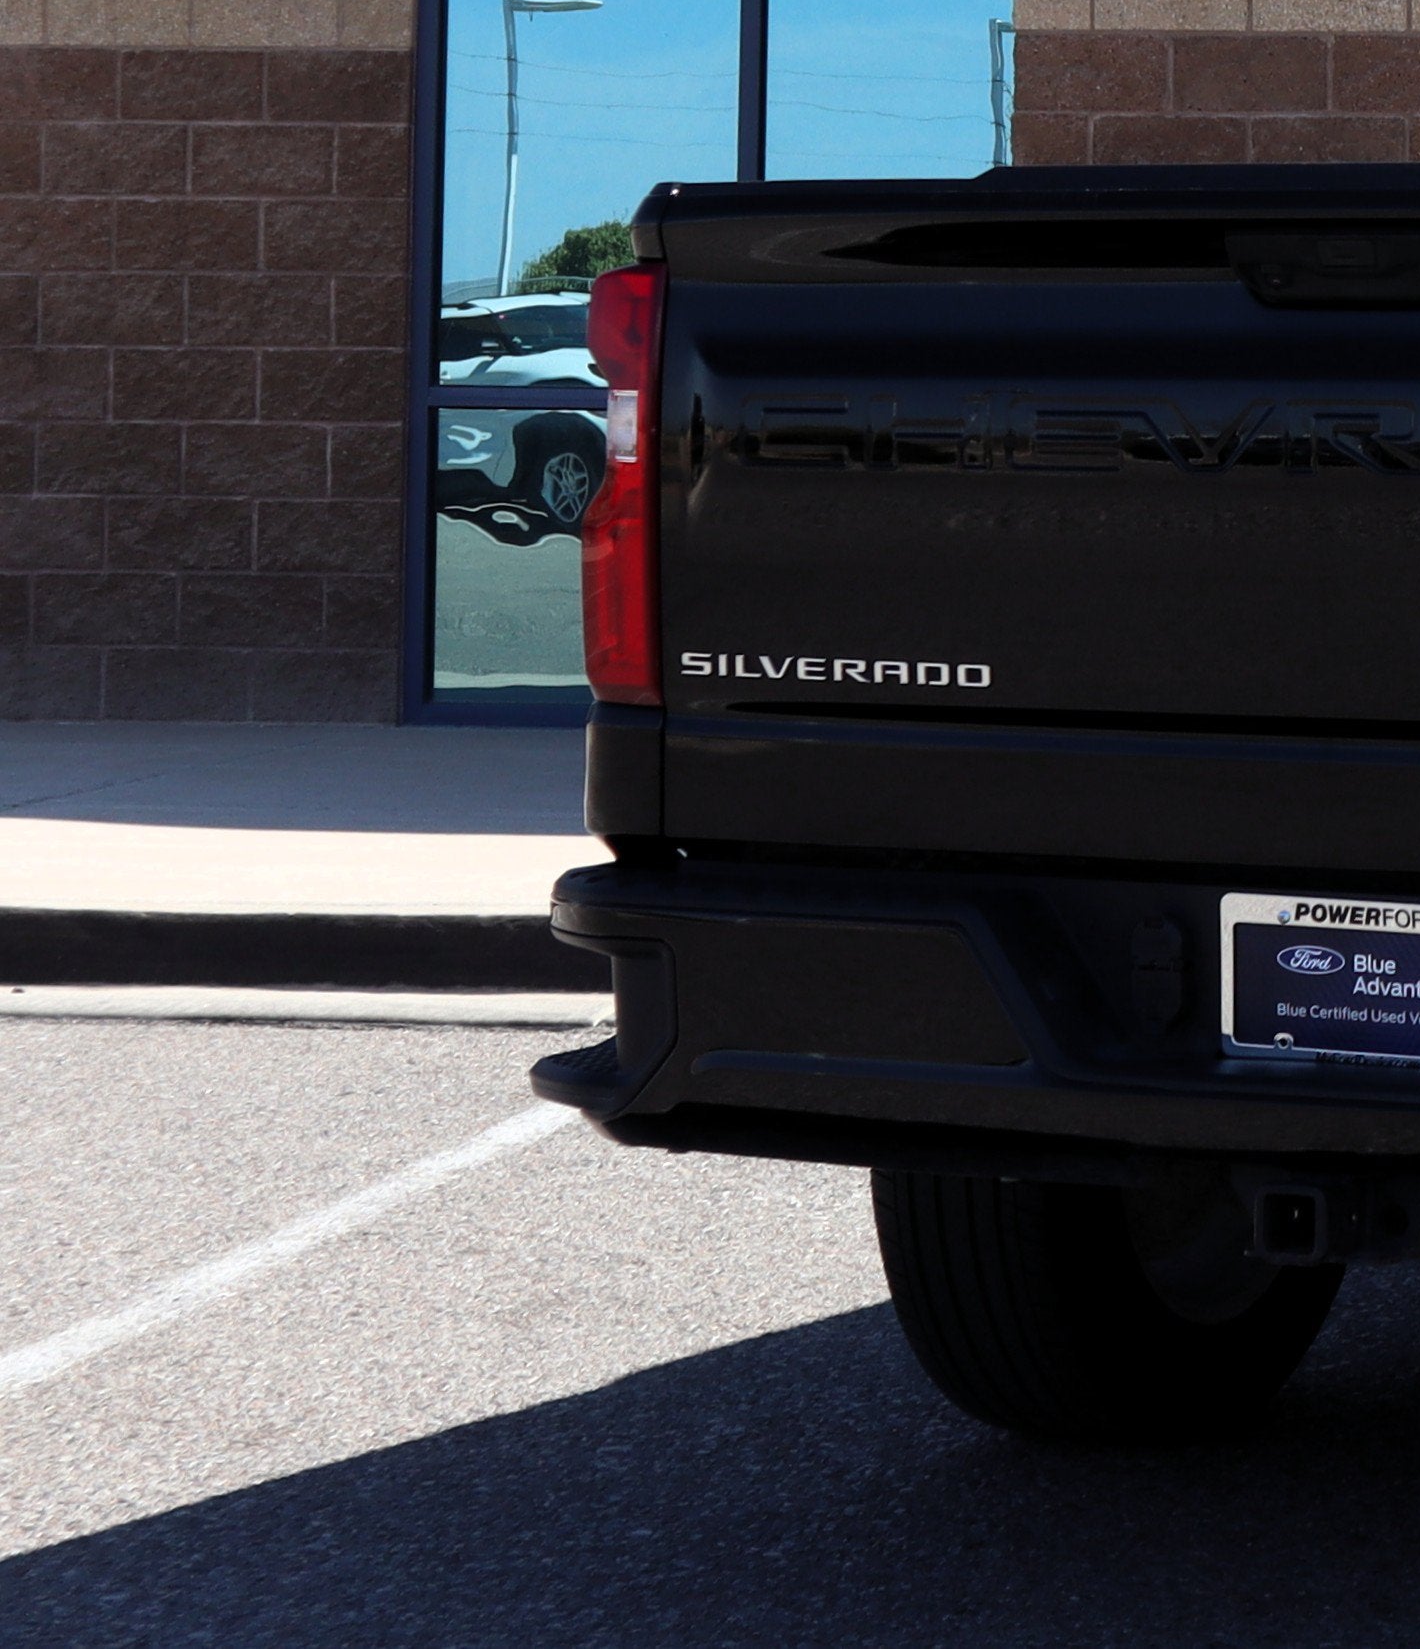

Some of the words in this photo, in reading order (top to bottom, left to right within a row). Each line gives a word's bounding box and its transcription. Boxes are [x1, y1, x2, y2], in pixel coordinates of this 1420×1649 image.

[681, 652, 991, 687] SILVERADO
[1290, 950, 1331, 970] Ford
[1354, 954, 1395, 974] Blue
[1277, 1003, 1306, 1017] Blue
[1310, 1005, 1367, 1022] Certified
[1371, 1009, 1406, 1024] Used
